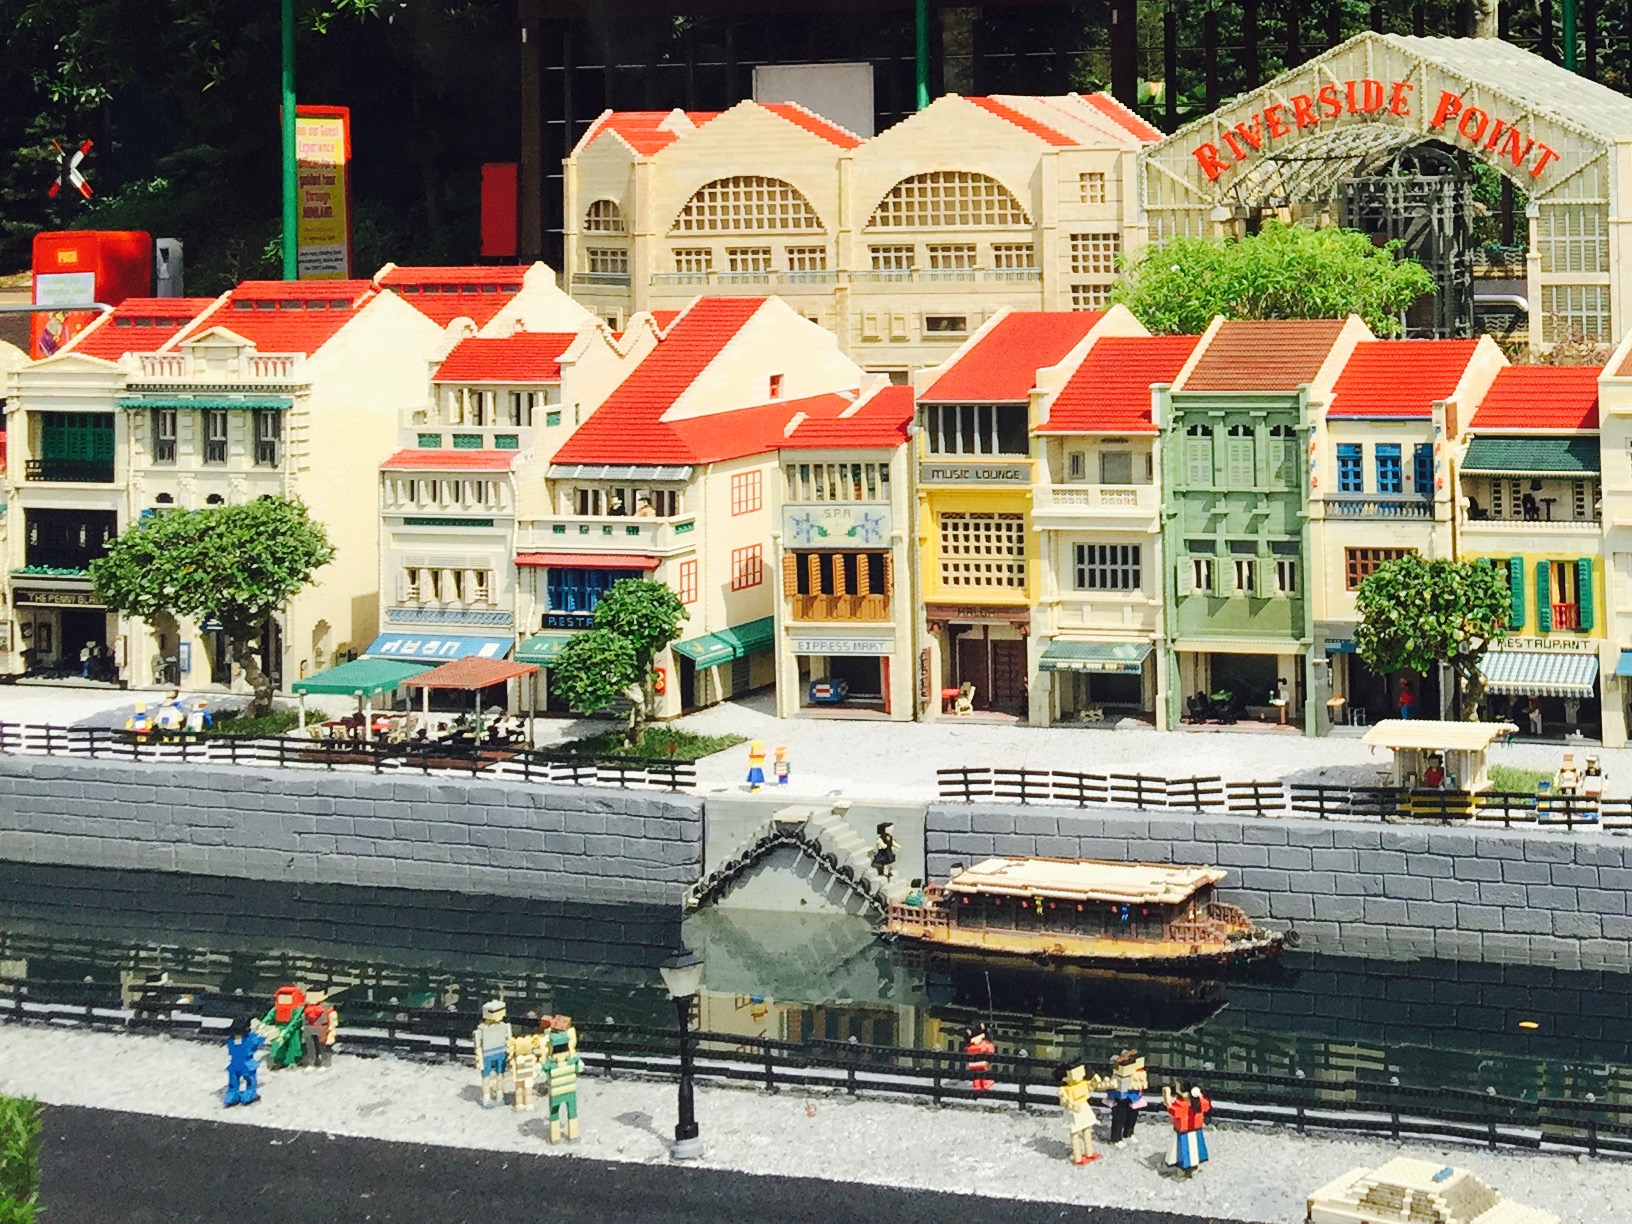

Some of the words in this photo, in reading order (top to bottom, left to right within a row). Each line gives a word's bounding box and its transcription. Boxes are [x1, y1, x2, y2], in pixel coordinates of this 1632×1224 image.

[1192, 79, 1413, 182] RIVERSIDE
[1430, 89, 1561, 179] POINT
[932, 469, 969, 479] MUSIC
[975, 470, 1020, 480] LOUNGE
[824, 508, 851, 518] SPA
[27, 592, 47, 603] THE
[797, 641, 850, 651] EXPRESS
[853, 642, 886, 652] MART
[1497, 638, 1591, 650] RESTAURANT
